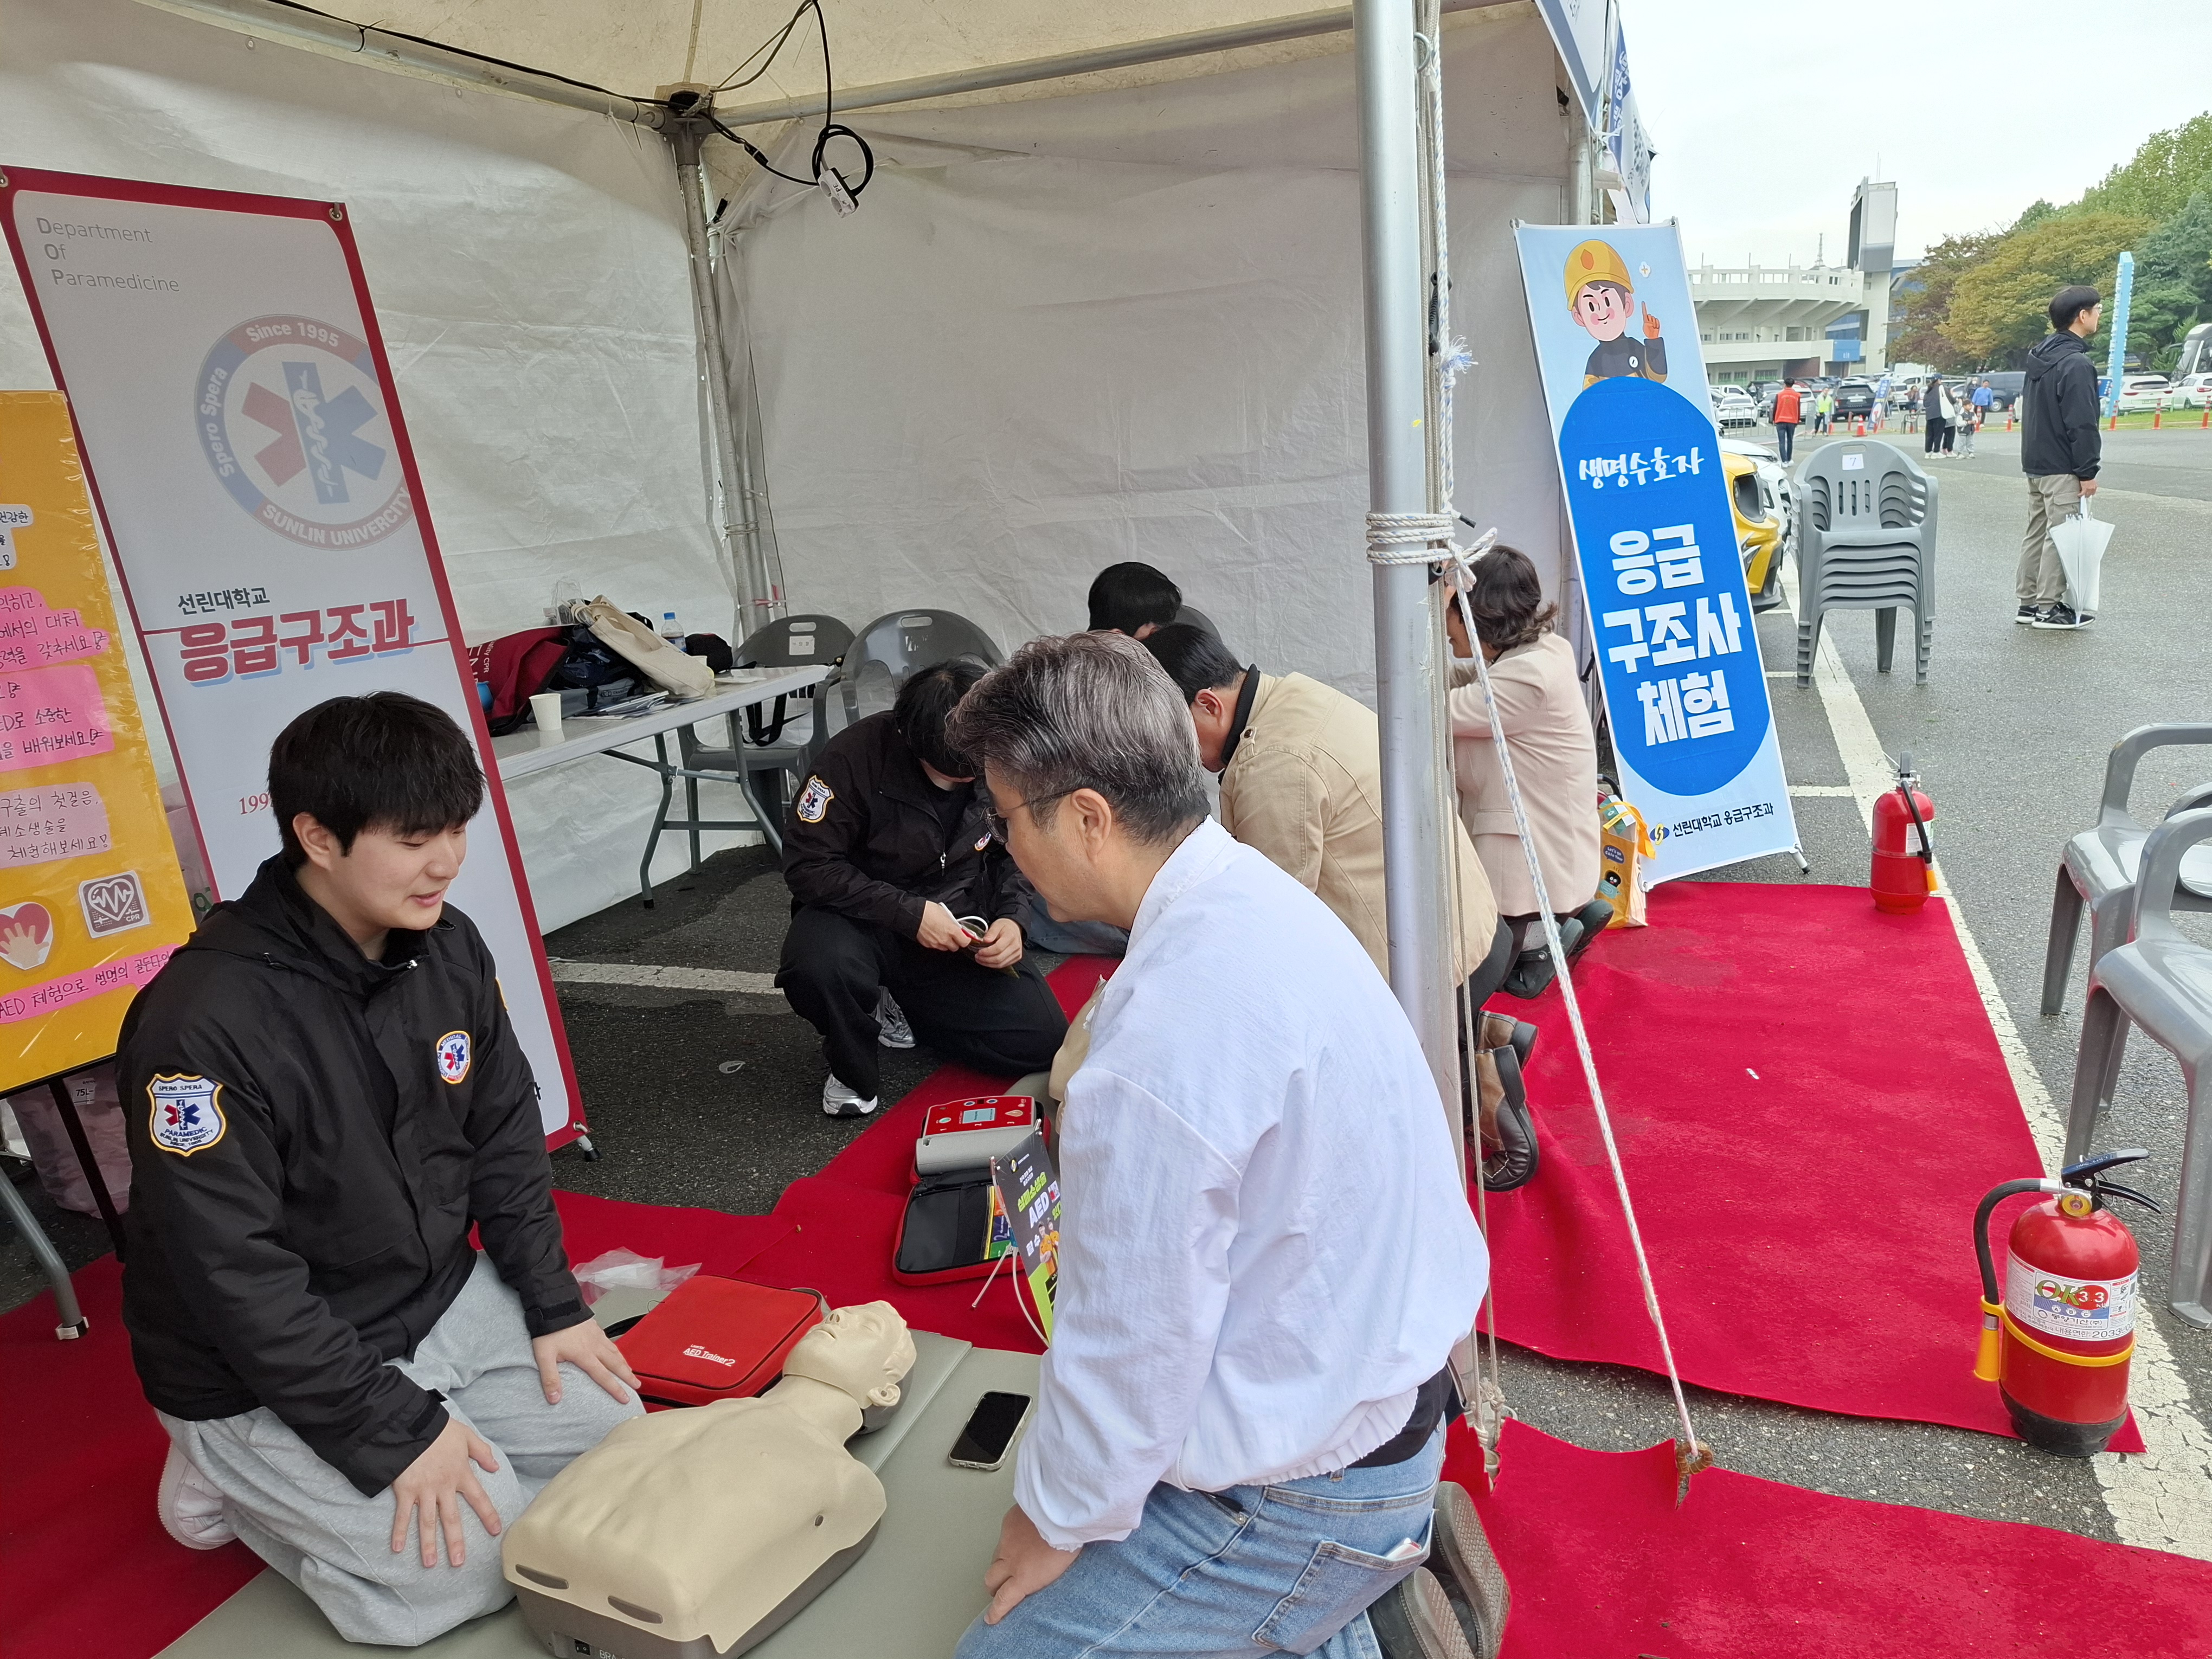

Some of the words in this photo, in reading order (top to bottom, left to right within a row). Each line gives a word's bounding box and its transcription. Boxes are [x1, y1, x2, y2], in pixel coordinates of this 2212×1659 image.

[36, 217, 153, 243] Department
[44, 244, 66, 260] Of
[51, 269, 179, 292] Paramedicine
[246, 324, 292, 342] Since
[298, 322, 339, 347] 1995
[201, 367, 228, 416] Spera
[206, 422, 235, 477] Spero
[1850, 458, 1856, 466] 7
[1579, 447, 1704, 489] 생명수호자
[262, 504, 325, 544] SUNLIN
[1610, 523, 1704, 595] 응급
[177, 587, 270, 615] 선린대학교
[46, 610, 79, 628] 대처
[1603, 592, 1742, 673] 구조사
[179, 598, 415, 682] 응급구조과
[0, 712, 26, 731] D로
[35, 707, 72, 725] 소중한
[1636, 670, 1734, 747] 체험
[1673, 814, 1722, 837] 선린대학교
[1724, 802, 1774, 825] 응급구조과
[8, 834, 107, 860] 체험해보세요!
[126, 914, 140, 922] CPR
[31, 979, 89, 1007] 체험으로
[95, 962, 128, 986] 생명의
[164, 1127, 207, 1137] PARAMEDIC
[1018, 1171, 1047, 1212] 심폐소생술
[1029, 1192, 1049, 1228] AED
[2036, 1279, 2086, 1306] OK
[2079, 1291, 2104, 1303] 3.3
[683, 1348, 702, 1356] AED
